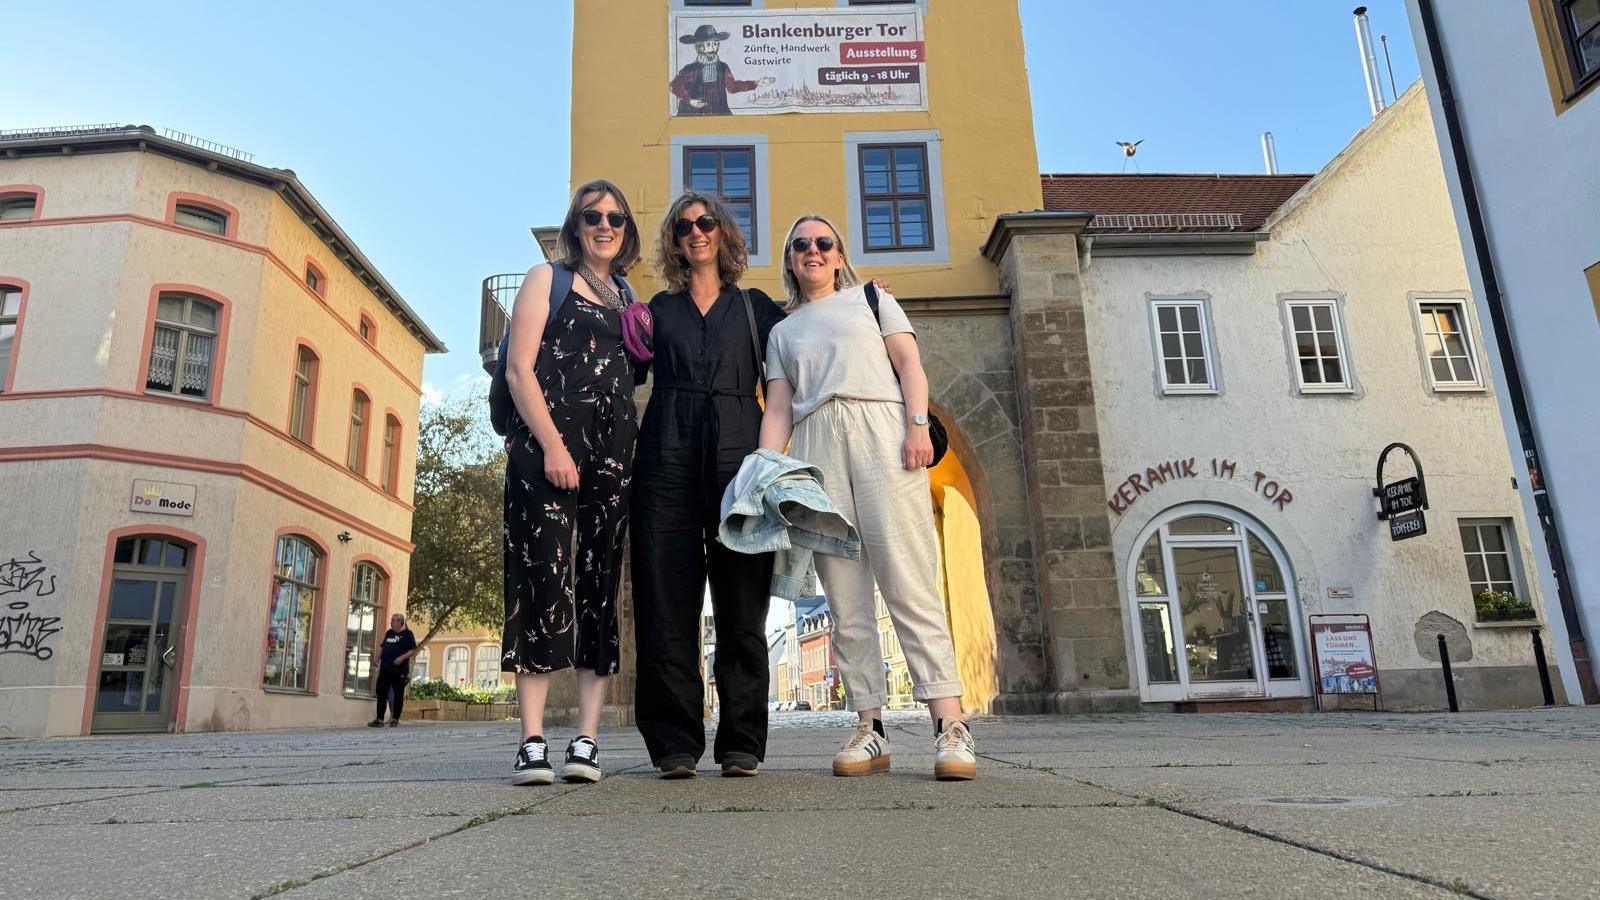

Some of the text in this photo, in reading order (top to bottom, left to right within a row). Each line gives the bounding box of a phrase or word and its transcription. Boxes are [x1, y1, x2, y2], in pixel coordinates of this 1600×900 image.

[742, 22, 907, 41] Blankenburger Tor
[743, 43, 831, 54] Zünfte, Handwerk
[846, 46, 917, 59] Ausstellung
[743, 56, 792, 66] Gastwirte
[824, 70, 860, 82] täglich
[861, 73, 869, 81] 9
[876, 71, 888, 80] 18
[889, 70, 910, 80] Uhr
[1107, 456, 1294, 516] KERAMIK IM TOR
[1386, 482, 1413, 498] KERAMIK
[135, 496, 192, 510] Do Mode
